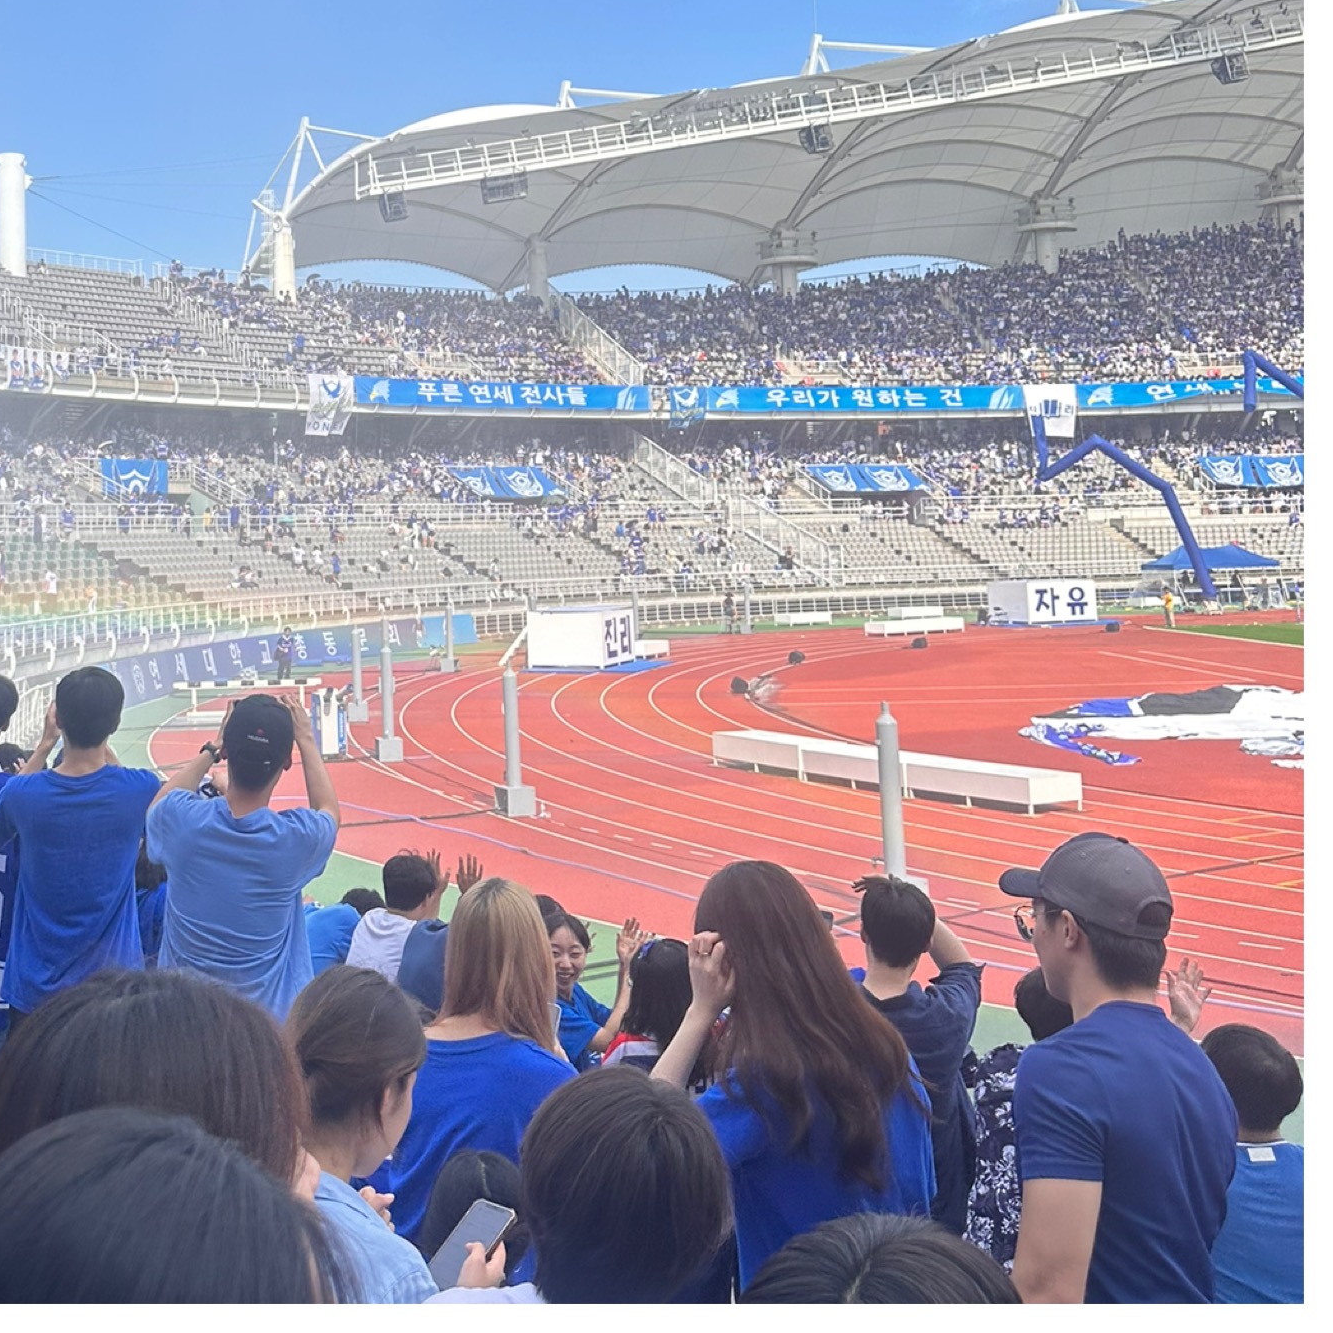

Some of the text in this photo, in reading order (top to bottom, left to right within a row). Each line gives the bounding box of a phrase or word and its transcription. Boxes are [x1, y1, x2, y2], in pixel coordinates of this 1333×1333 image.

[418, 380, 588, 407] 푸른 연세 전사들
[766, 389, 964, 409] 우리가 원하는 건
[1035, 586, 1089, 616] 자유
[603, 617, 634, 659] 진리
